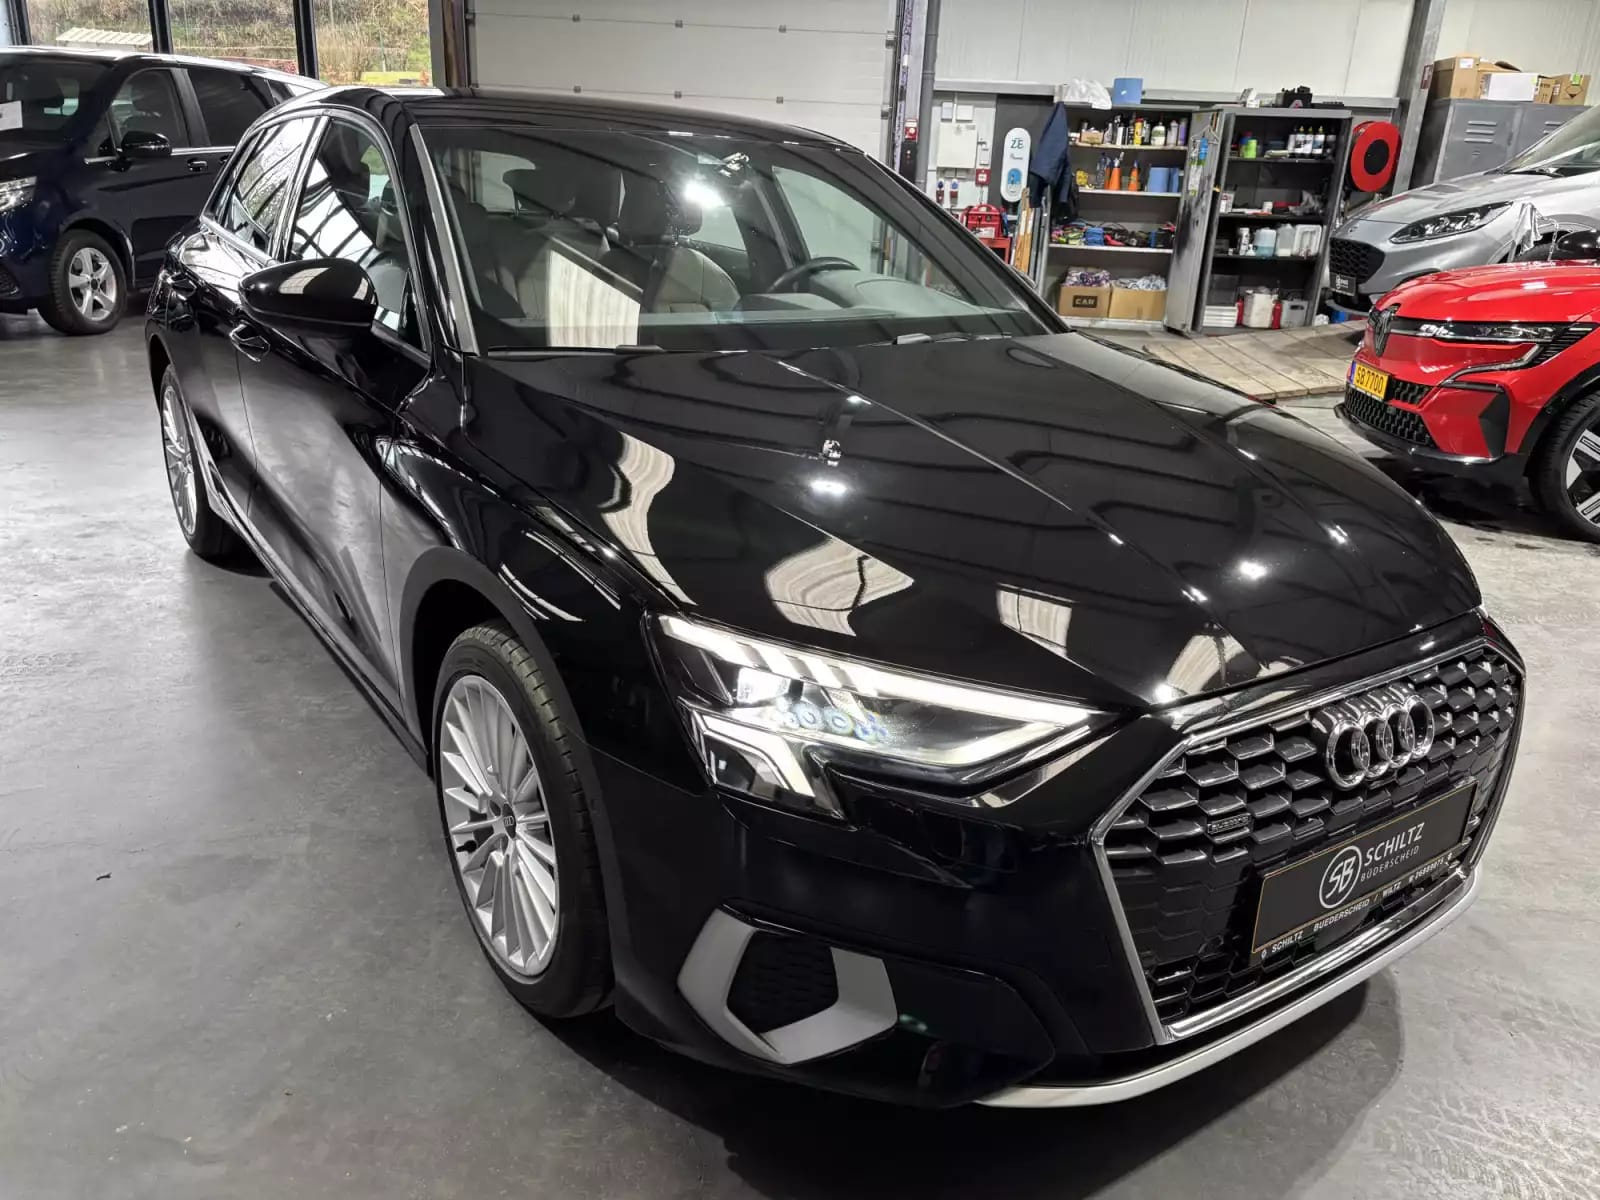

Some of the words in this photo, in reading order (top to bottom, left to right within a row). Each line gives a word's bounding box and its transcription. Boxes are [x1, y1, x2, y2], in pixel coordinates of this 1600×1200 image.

[1364, 822, 1425, 867] SCHILTZ
[1325, 856, 1357, 899] SB
[1271, 929, 1304, 953] SCHILTZ
[1313, 898, 1371, 932] BUEDERSCHEID
